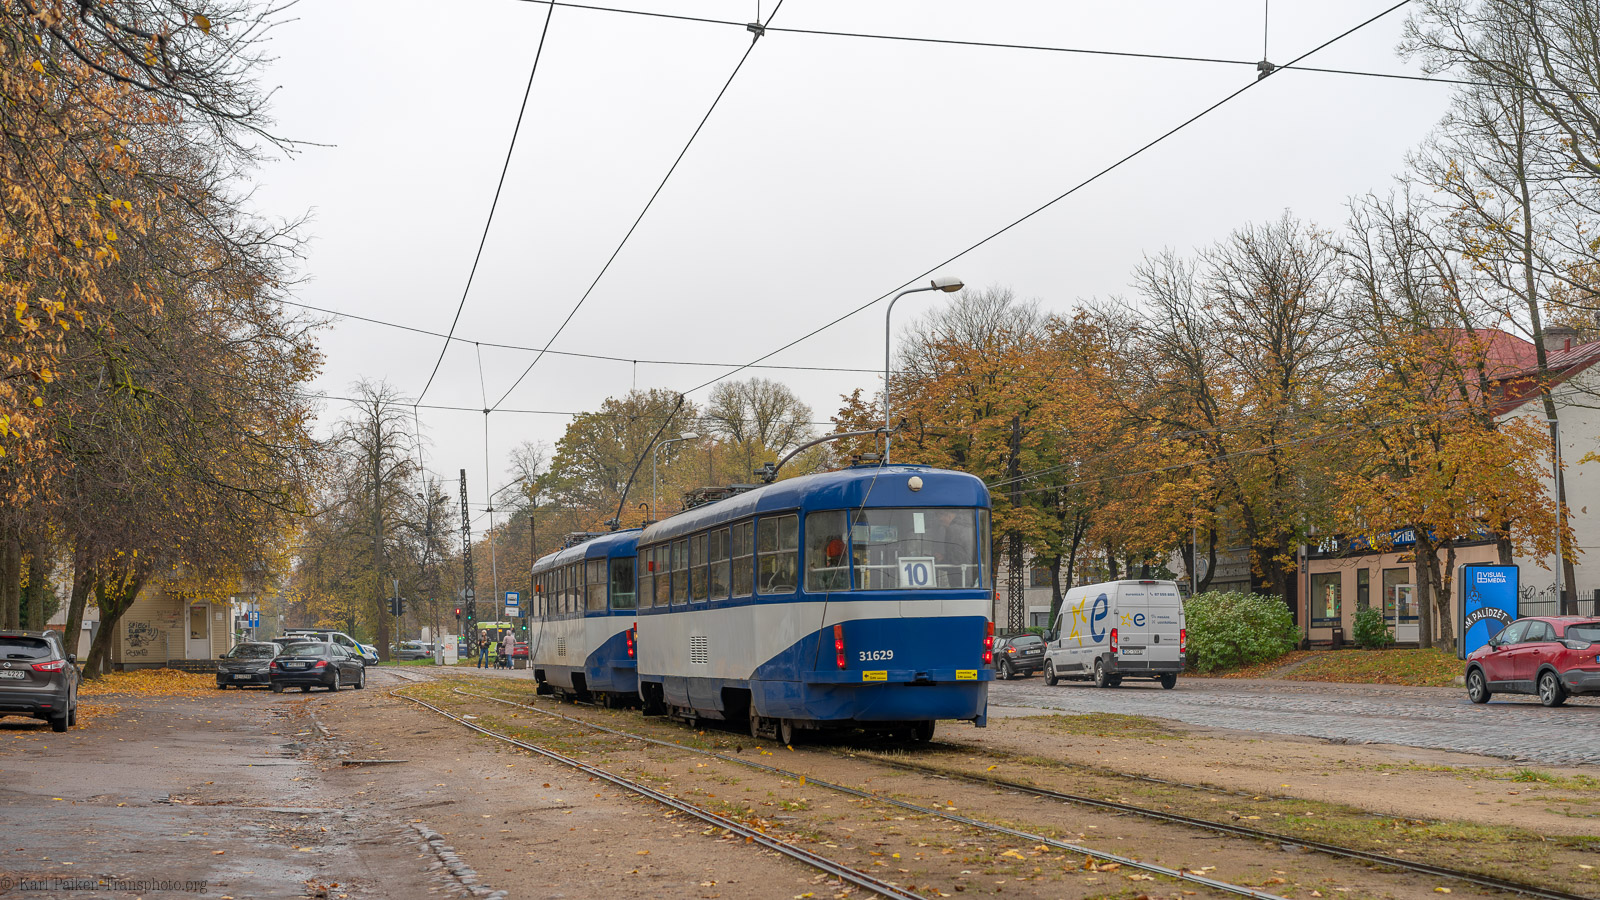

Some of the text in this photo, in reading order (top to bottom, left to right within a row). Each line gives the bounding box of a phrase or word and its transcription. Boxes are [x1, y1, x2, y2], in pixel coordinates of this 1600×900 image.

[1392, 529, 1416, 543] APTIEK
[904, 563, 929, 586] 10
[1472, 607, 1508, 621] PALĪDZĒT
[859, 650, 894, 661] 31629
